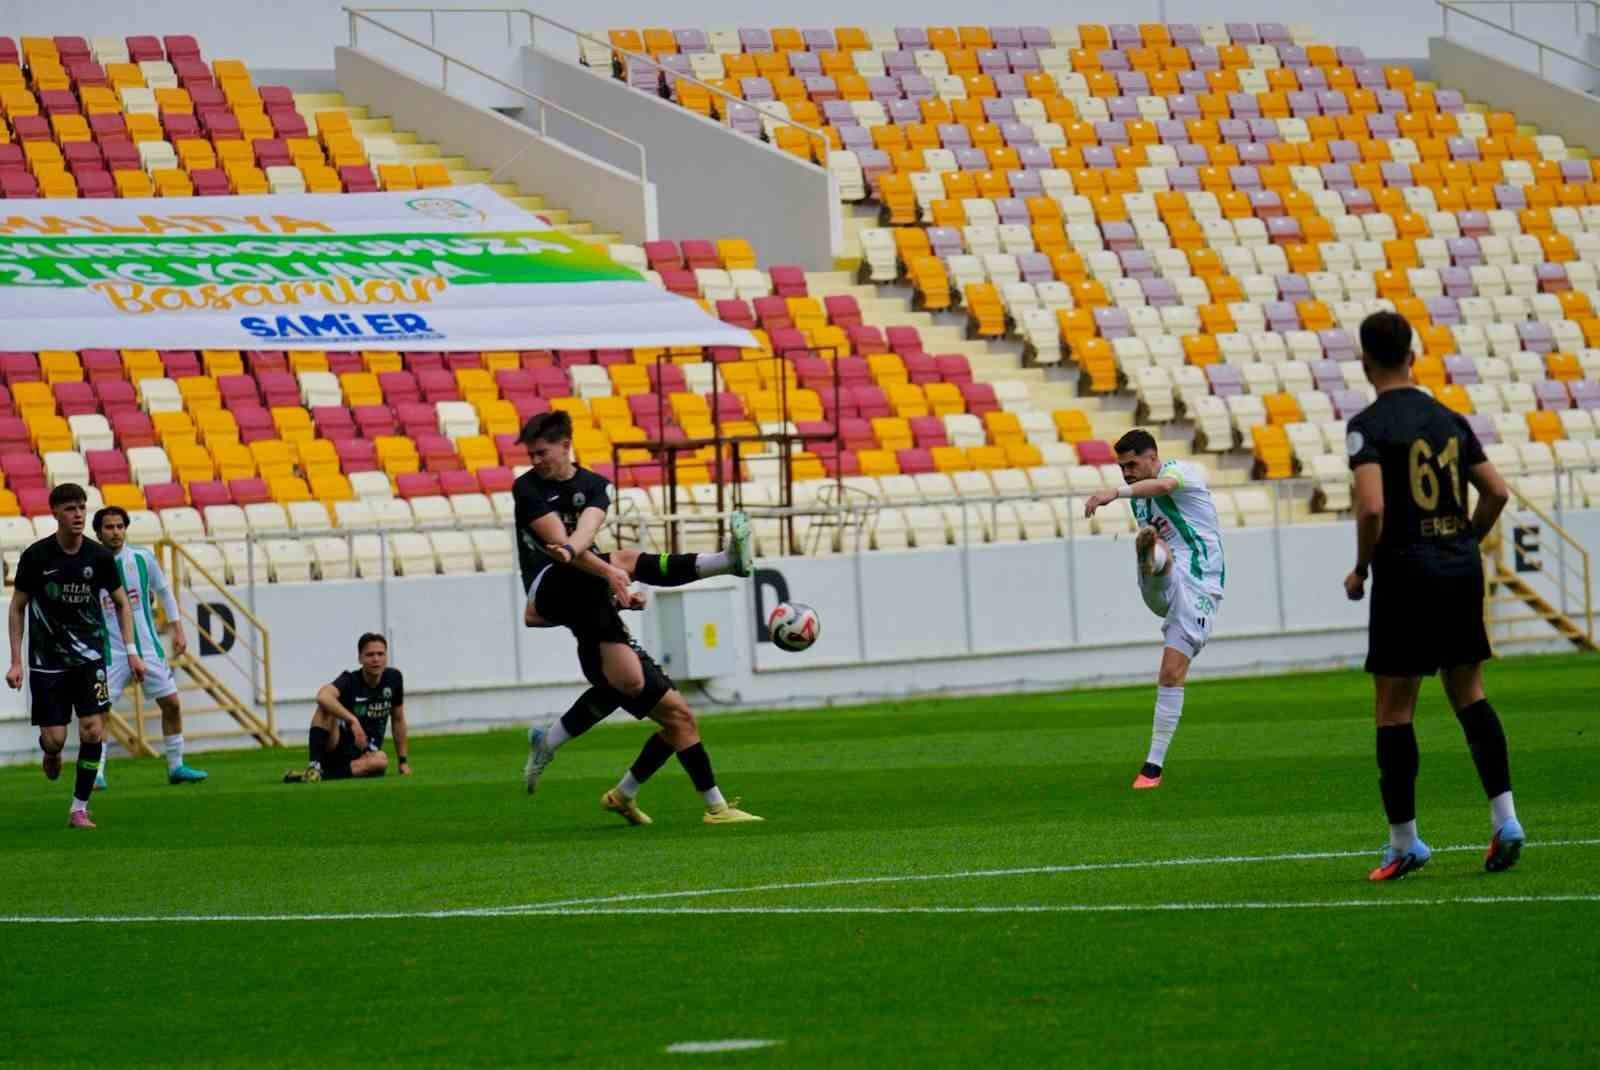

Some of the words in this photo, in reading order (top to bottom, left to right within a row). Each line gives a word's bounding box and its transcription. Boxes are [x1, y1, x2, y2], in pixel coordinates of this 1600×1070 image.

[363, 313, 435, 334] ER
[1409, 436, 1461, 511] 61
[1514, 526, 1543, 572] E
[197, 602, 236, 656] D
